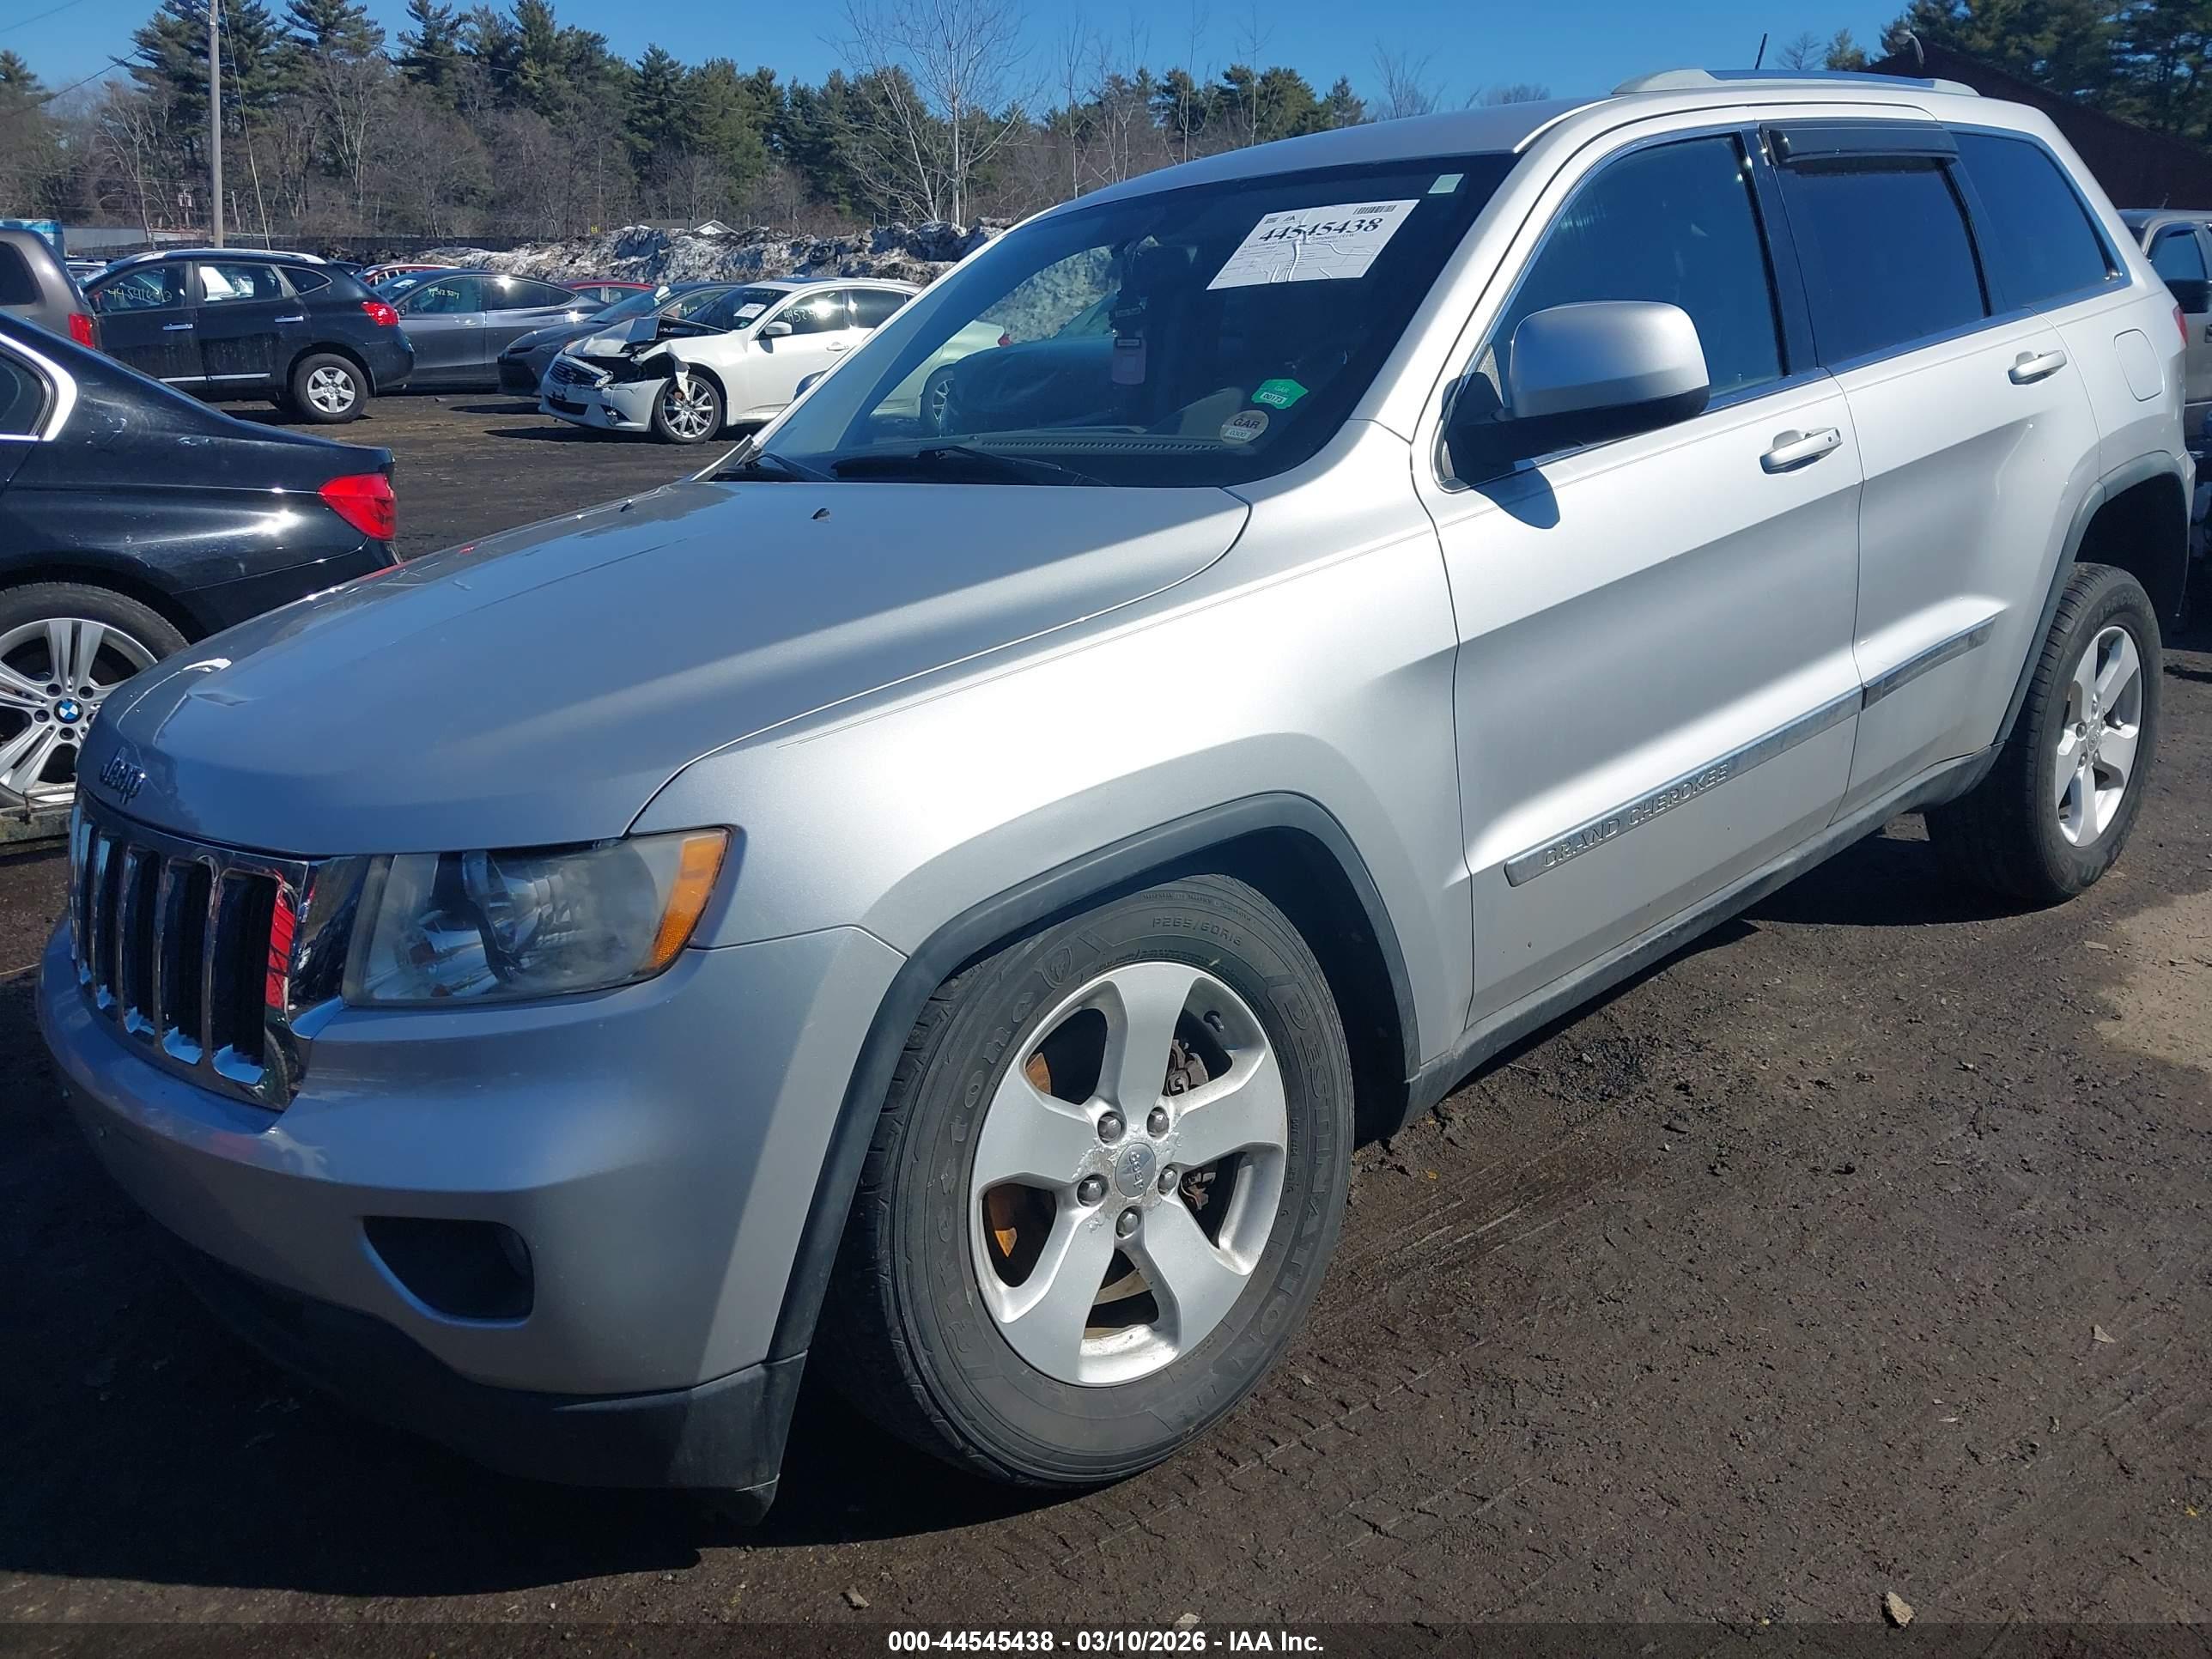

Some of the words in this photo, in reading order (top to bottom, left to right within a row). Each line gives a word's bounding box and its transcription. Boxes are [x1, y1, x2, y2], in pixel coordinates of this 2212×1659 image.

[1258, 217, 1383, 241] 44545438
[1233, 417, 1261, 430] GAR
[1544, 817, 1620, 867] GRAND
[1628, 763, 1729, 826] CHEROKEE
